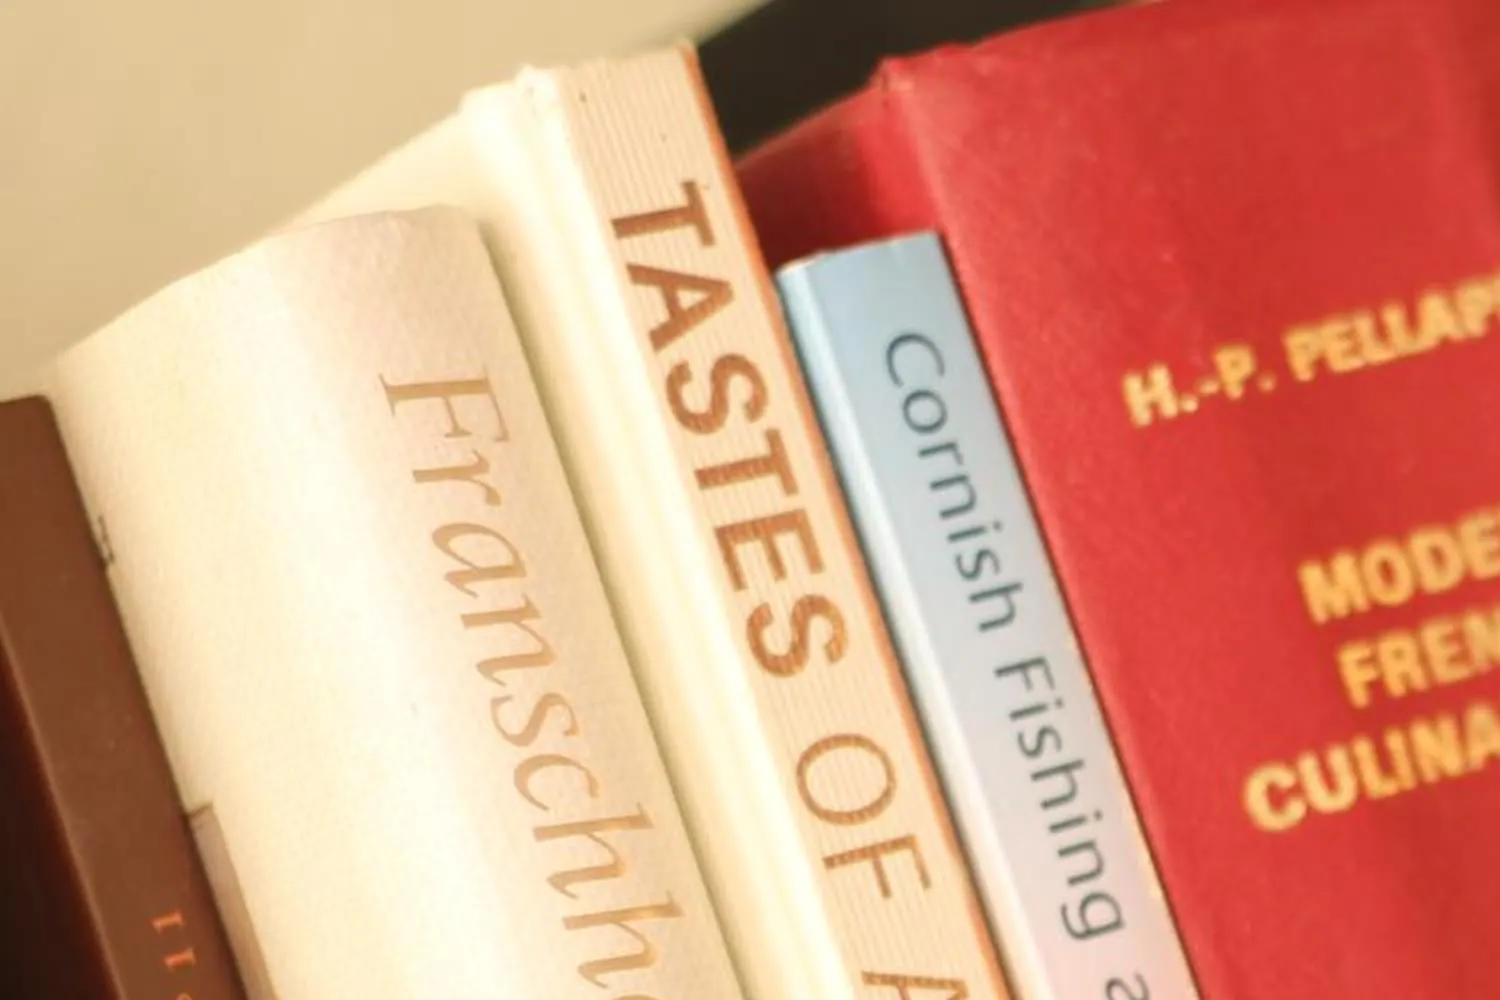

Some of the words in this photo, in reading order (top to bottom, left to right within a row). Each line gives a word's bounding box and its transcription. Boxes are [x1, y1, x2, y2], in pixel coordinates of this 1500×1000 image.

[611, 178, 848, 678] TASTES
[796, 733, 932, 899] OF
[885, 331, 1026, 633] Cornish
[995, 655, 1124, 942] Fishing
